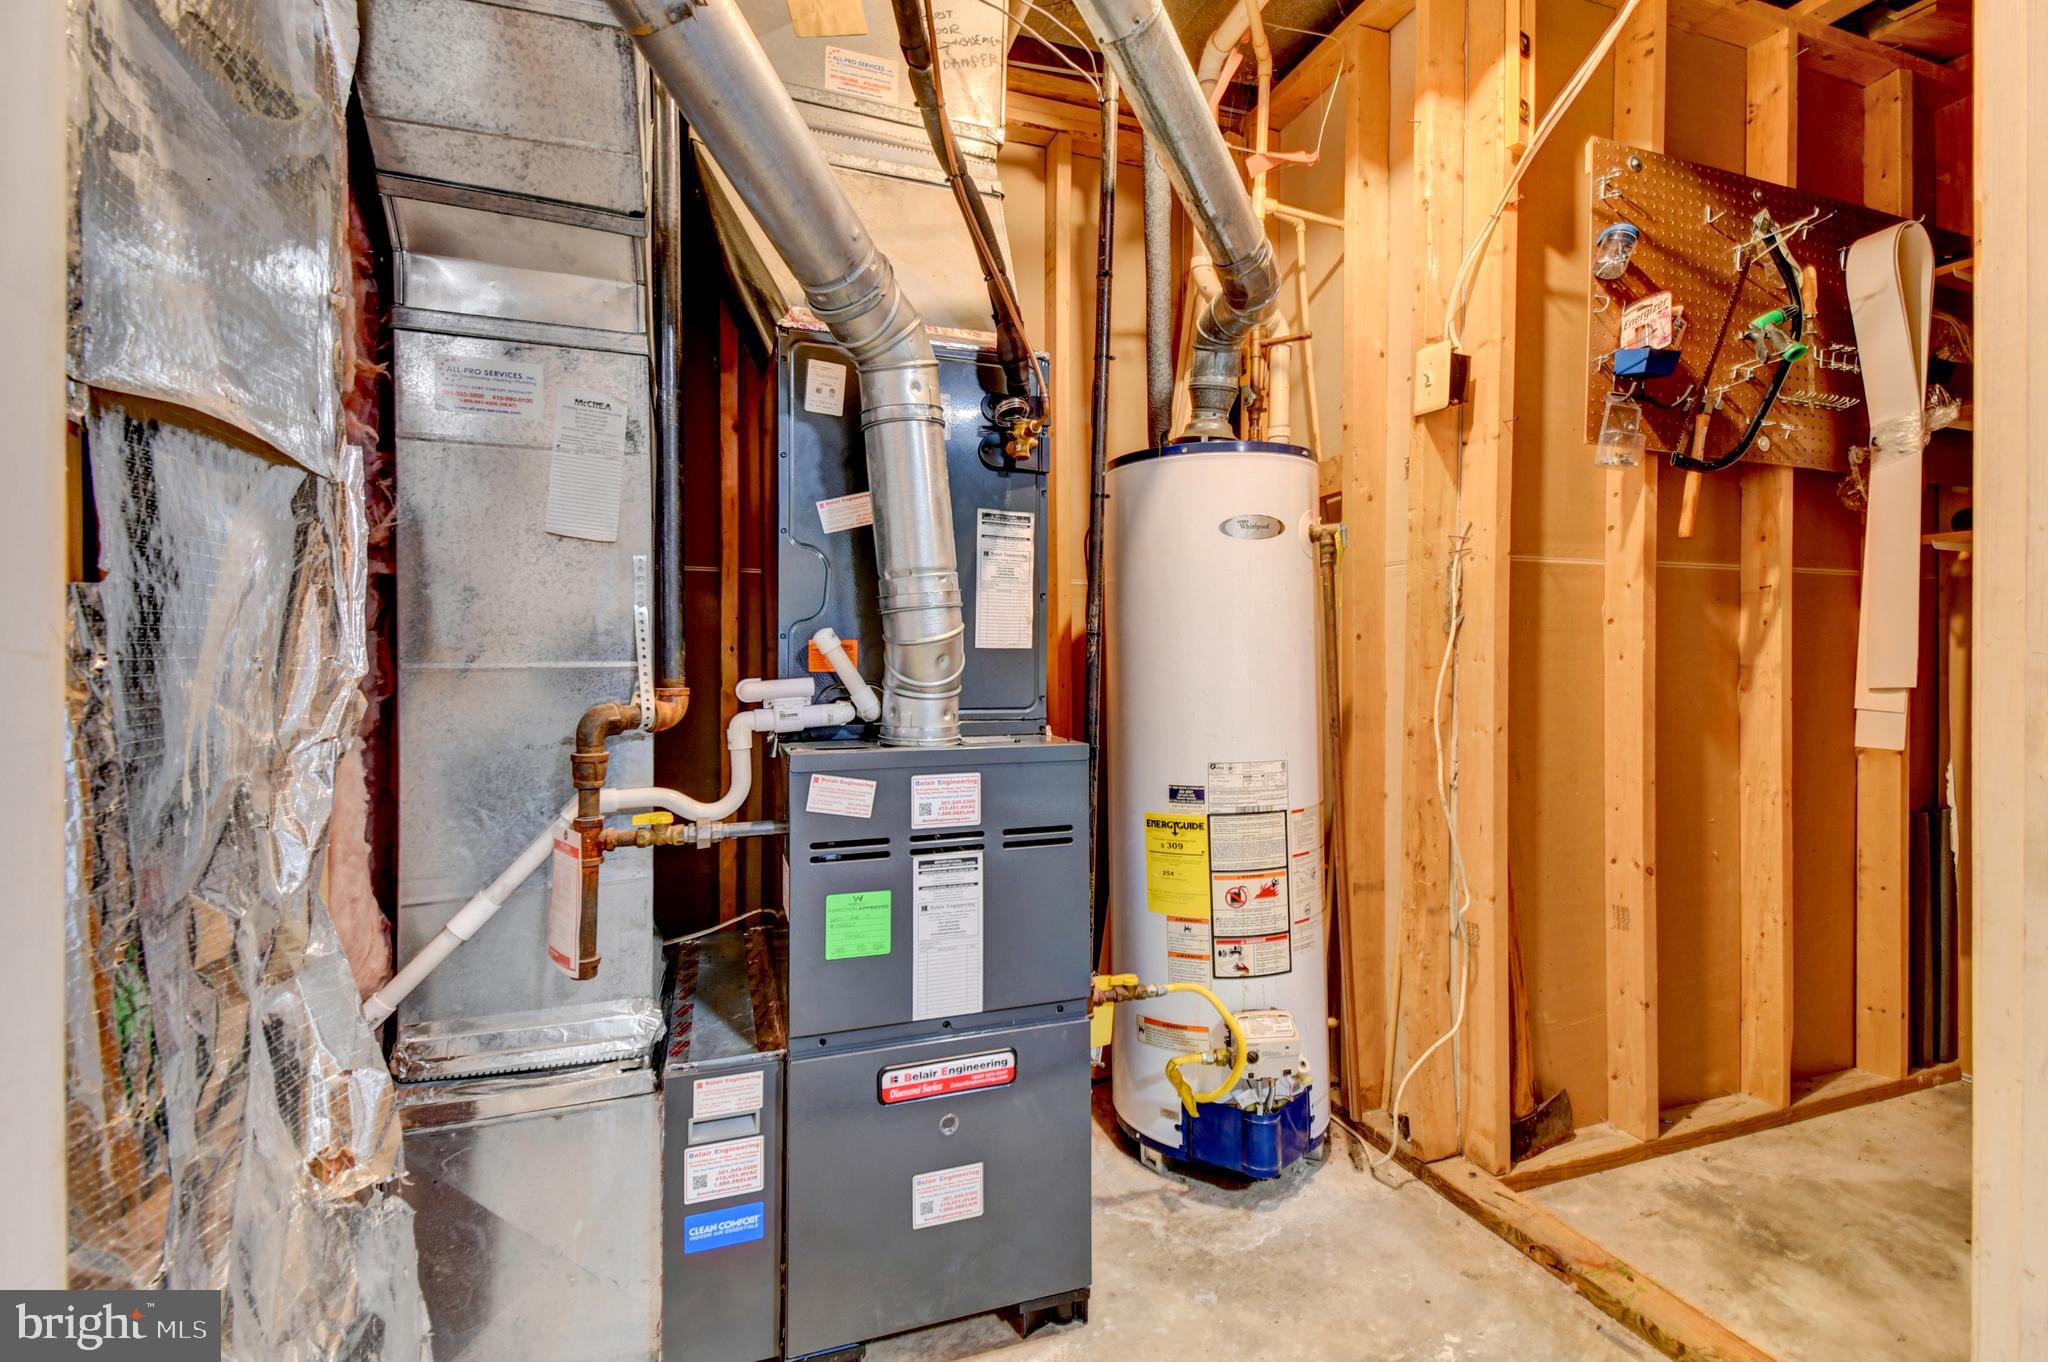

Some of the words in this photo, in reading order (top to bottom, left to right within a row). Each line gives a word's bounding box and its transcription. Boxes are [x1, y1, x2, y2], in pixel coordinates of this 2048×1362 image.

[833, 55, 857, 65] ALL-PRO
[858, 61, 885, 71] SERVICES
[943, 53, 997, 69] DAMPER
[1624, 297, 1668, 330] Energizer
[447, 366, 481, 375] ALL-PRO
[484, 370, 523, 379] SERVICES
[840, 780, 874, 788] Engineering
[938, 778, 977, 786] Engineering
[1146, 819, 1205, 832] ENERGYGUIDE
[1166, 842, 1184, 850] 309
[904, 1070, 938, 1082] Belair
[940, 1059, 1008, 1075] Engineering
[890, 1085, 921, 1099] Diamond
[921, 1082, 943, 1094] Series
[688, 1150, 712, 1159] Belair
[714, 1142, 760, 1155] Engineering
[916, 1177, 937, 1186] Belair
[939, 1169, 980, 1182] Engineering
[689, 1223, 717, 1236] CLEAN
[718, 1215, 760, 1229] COMFORT
[724, 1223, 759, 1234] ESSENTIALS
